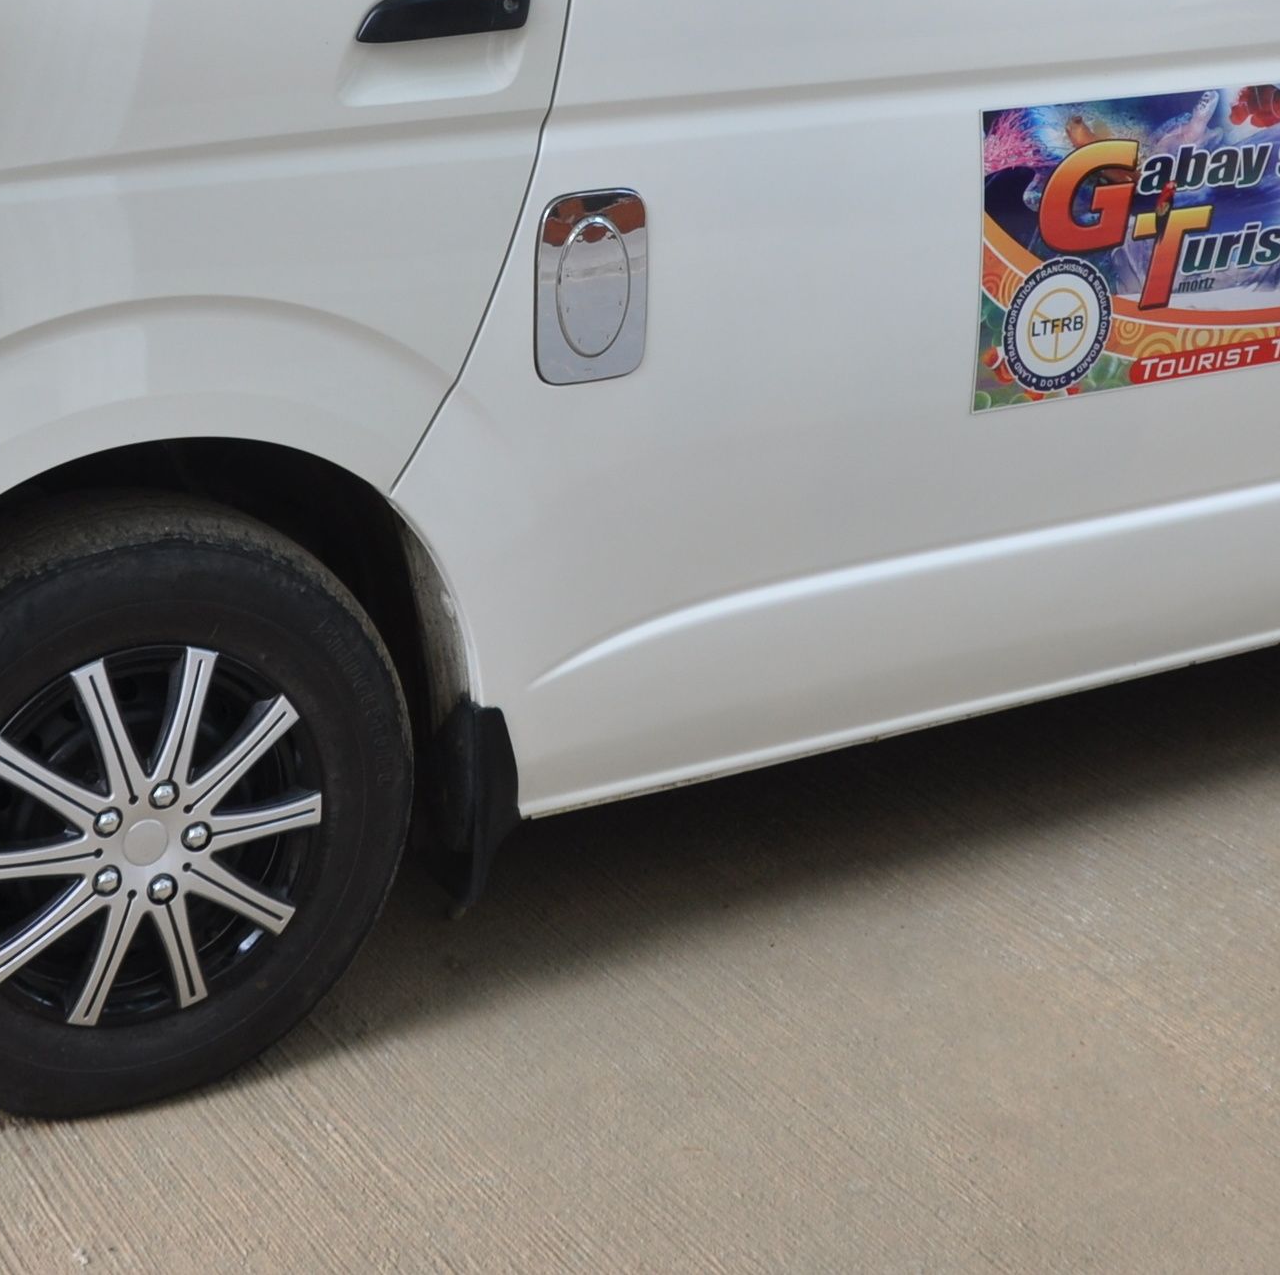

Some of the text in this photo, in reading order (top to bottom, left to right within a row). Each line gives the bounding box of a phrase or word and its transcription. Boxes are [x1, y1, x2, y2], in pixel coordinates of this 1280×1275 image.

[1038, 138, 1272, 252] Gabay
[1036, 263, 1089, 282] FRANCHISING
[1006, 279, 1036, 362] TRANSPORTATION
[1031, 315, 1084, 337] LTFRB
[1093, 280, 1109, 345] REGULATORY
[1014, 359, 1032, 381] LAND
[1140, 345, 1260, 380] TOURIST
[1040, 376, 1067, 387] DOTC
